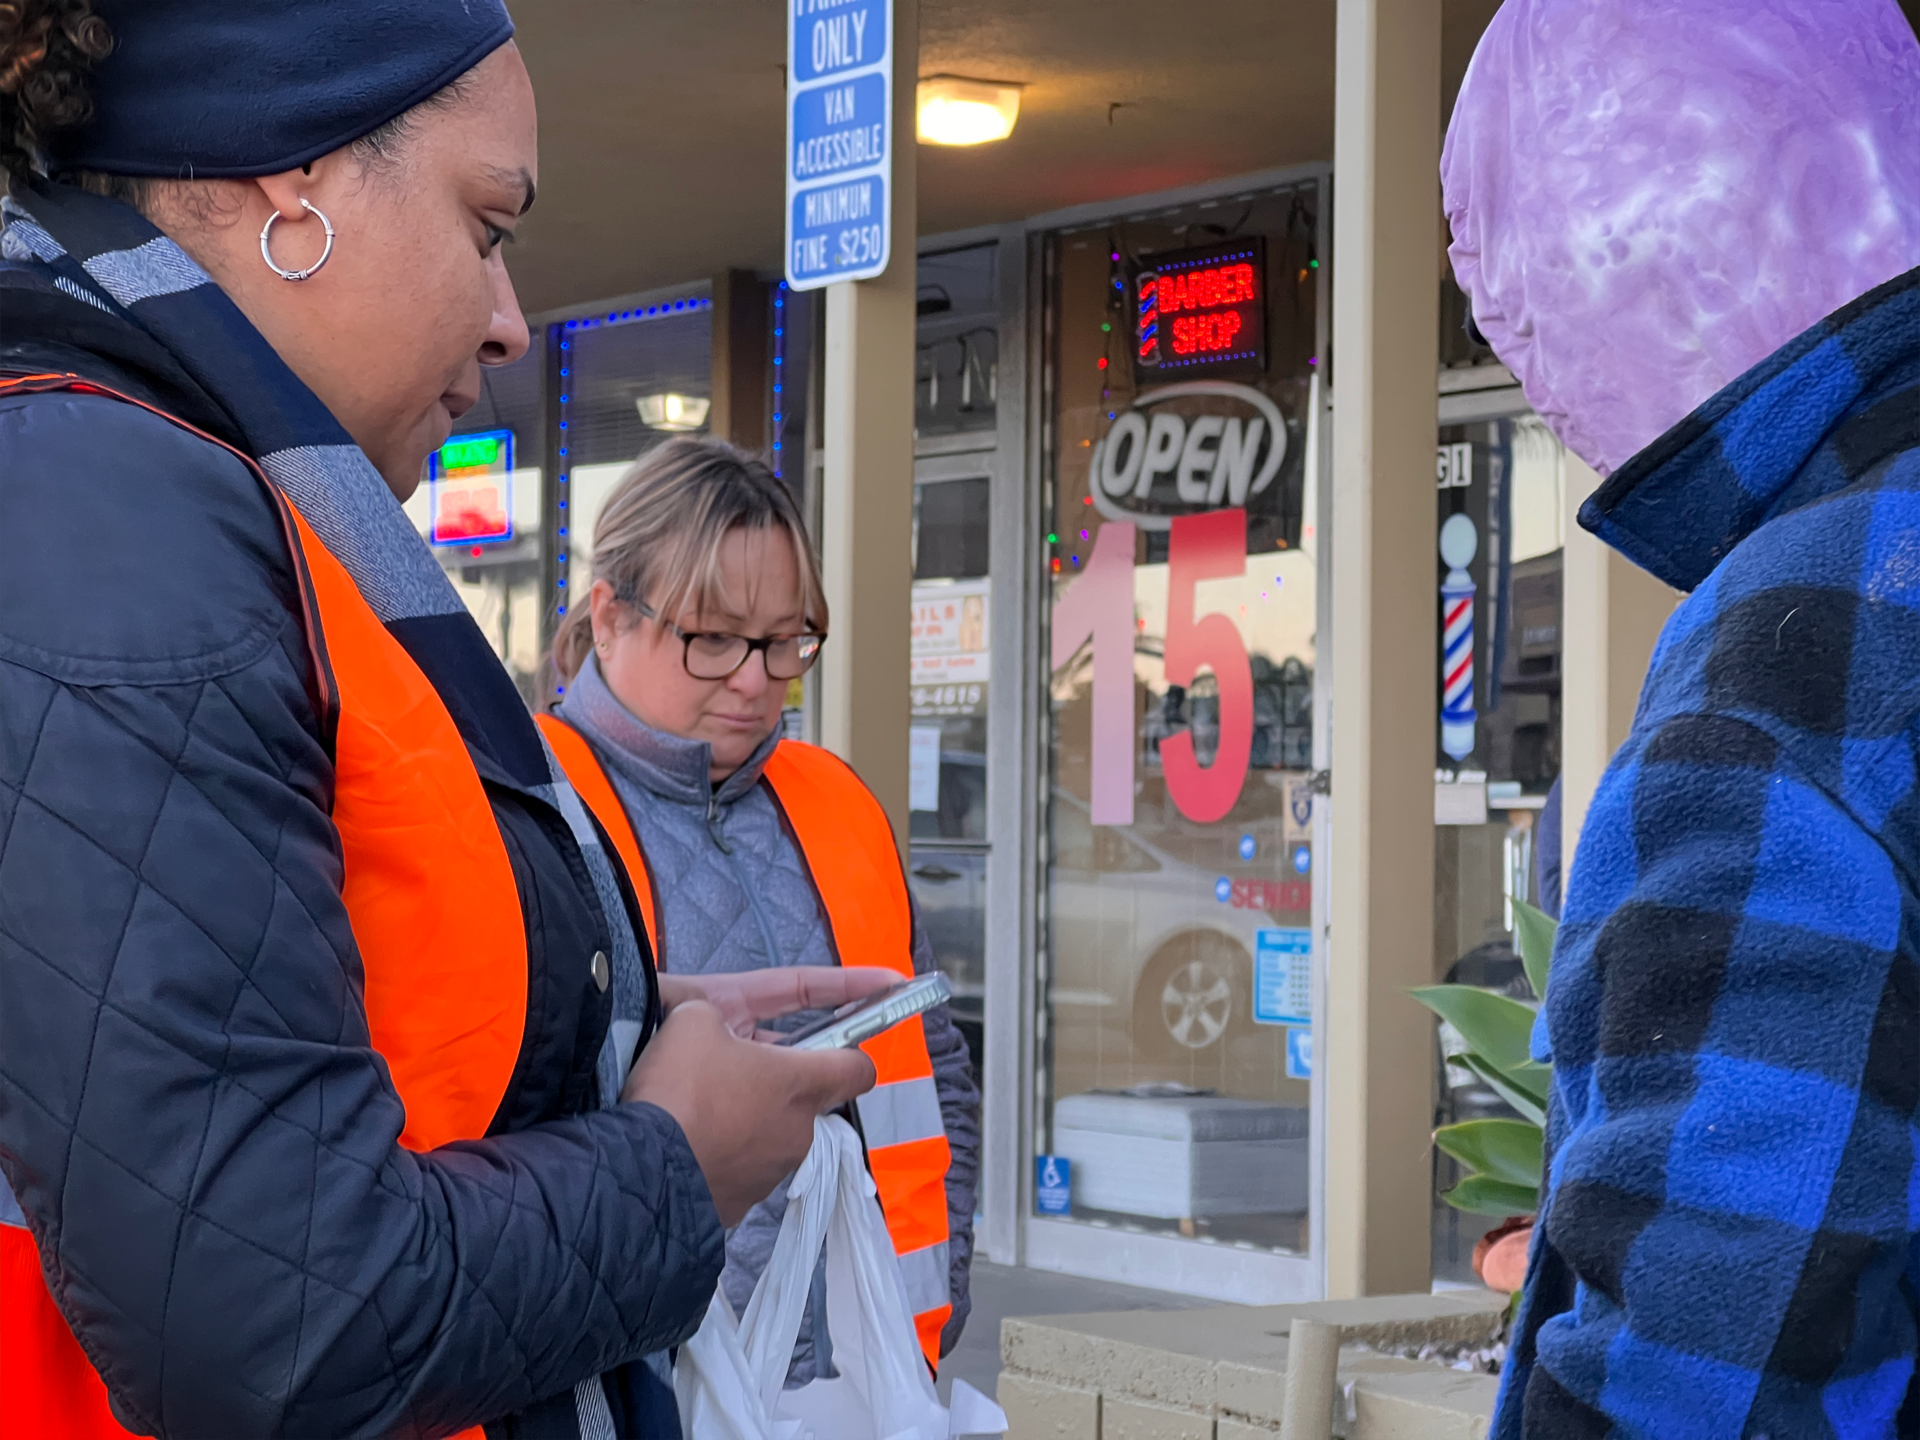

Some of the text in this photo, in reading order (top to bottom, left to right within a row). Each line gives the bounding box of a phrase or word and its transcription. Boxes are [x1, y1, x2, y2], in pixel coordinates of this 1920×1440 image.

[812, 9, 867, 73] ONLY
[824, 86, 855, 125] VAN
[796, 124, 882, 176] ACCESSIBLE
[805, 182, 871, 229] MINIMUM
[794, 225, 880, 274] FINE $250
[1158, 263, 1254, 313] BARBER
[1172, 310, 1242, 354] SHOP
[1102, 412, 1265, 506] OPEN
[1052, 508, 1254, 825] 15
